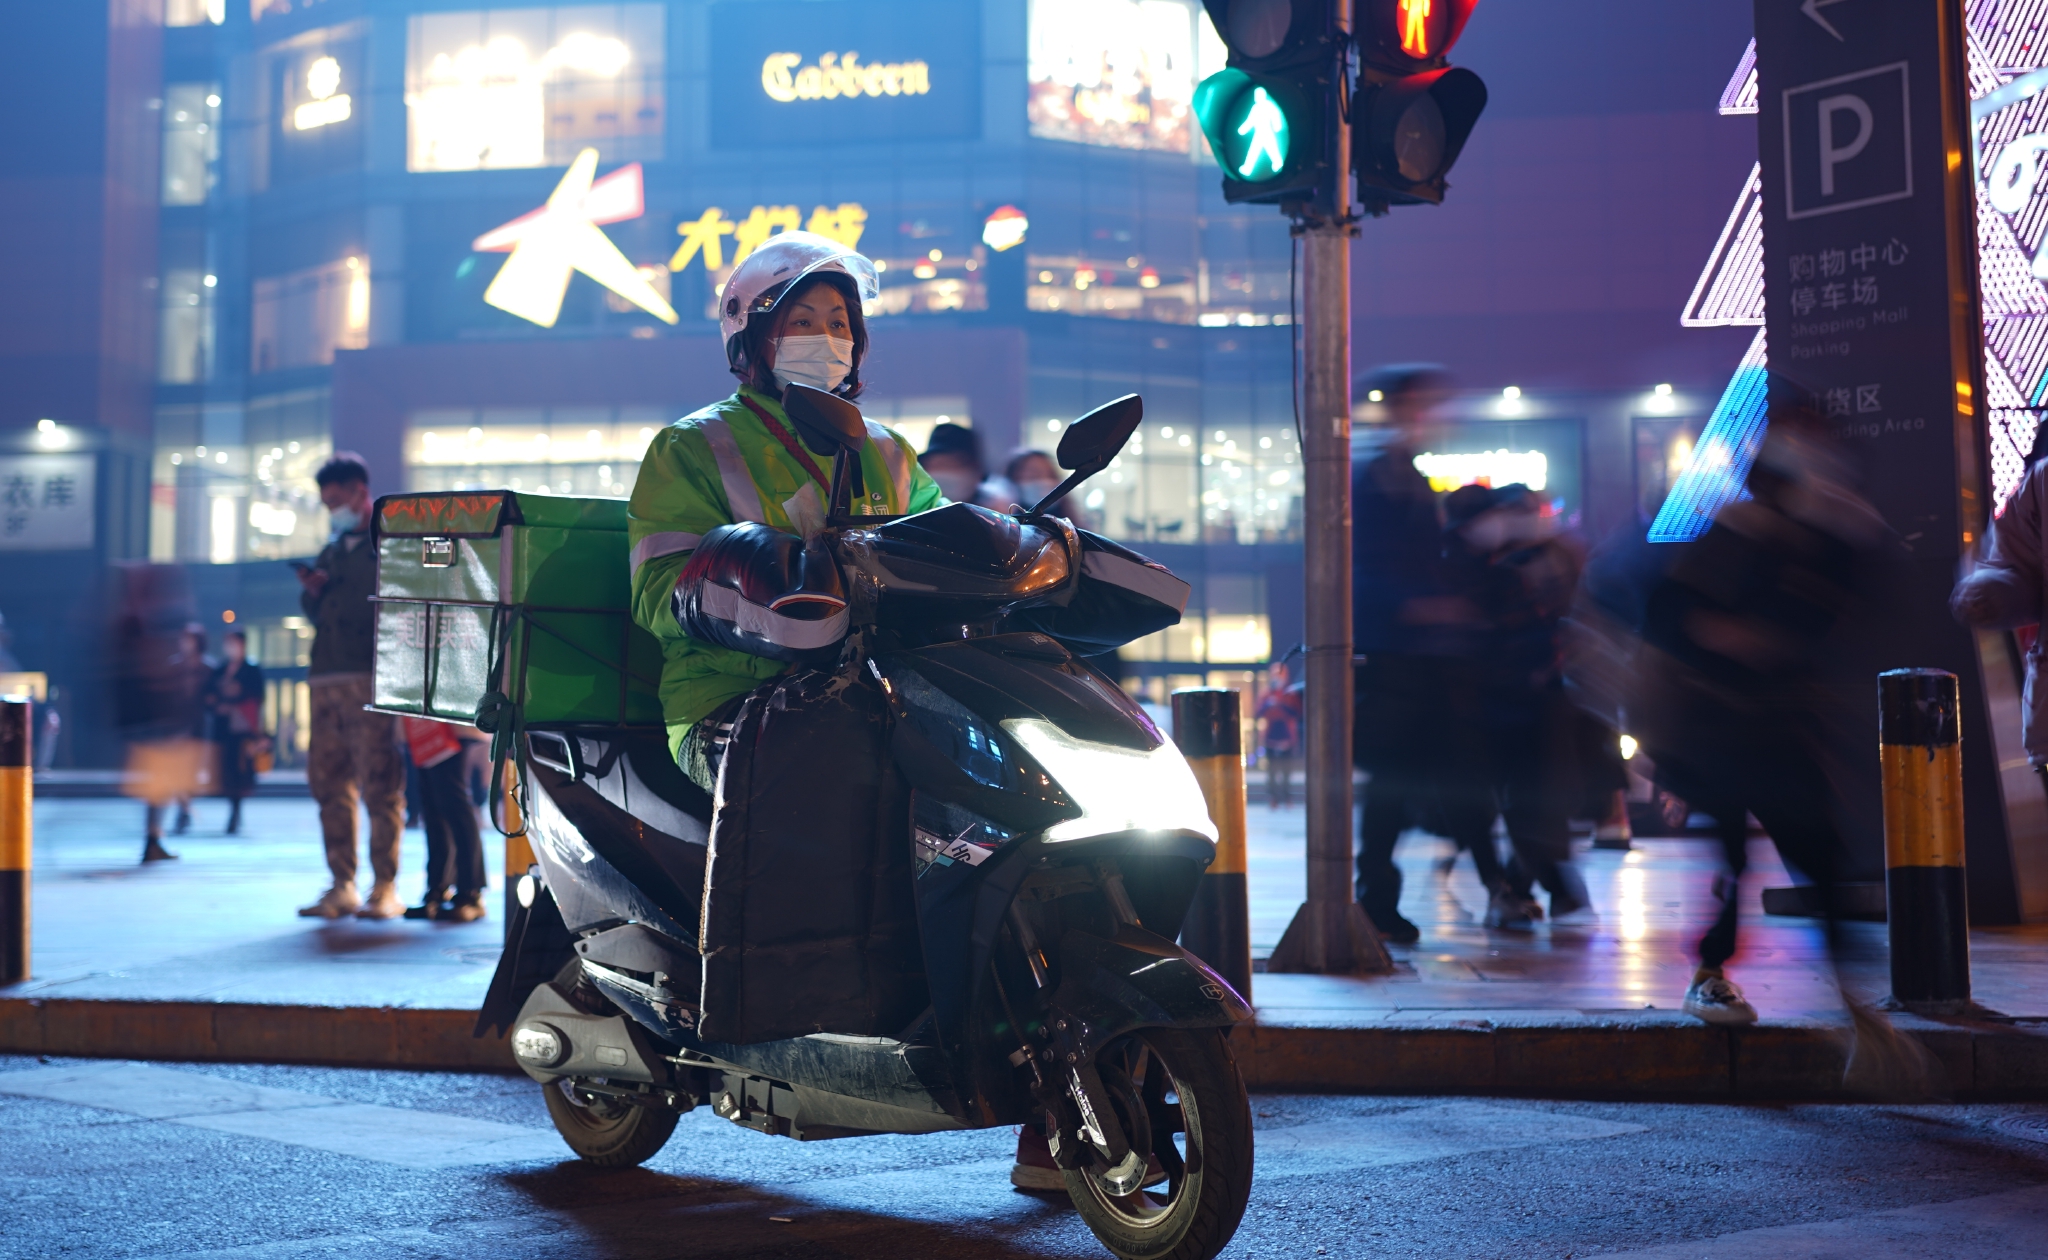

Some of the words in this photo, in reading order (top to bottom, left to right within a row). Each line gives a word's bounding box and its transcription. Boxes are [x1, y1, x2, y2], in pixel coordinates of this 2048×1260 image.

[1818, 94, 1874, 197] P
[1789, 237, 1909, 282] 购物中心
[1790, 276, 1879, 317] 停车场
[1791, 316, 1866, 338] Shopping
[1873, 306, 1907, 325] Mall
[1791, 341, 1850, 360] Parking
[1884, 417, 1925, 433] Area
[395, 611, 479, 650] 美团买菜
